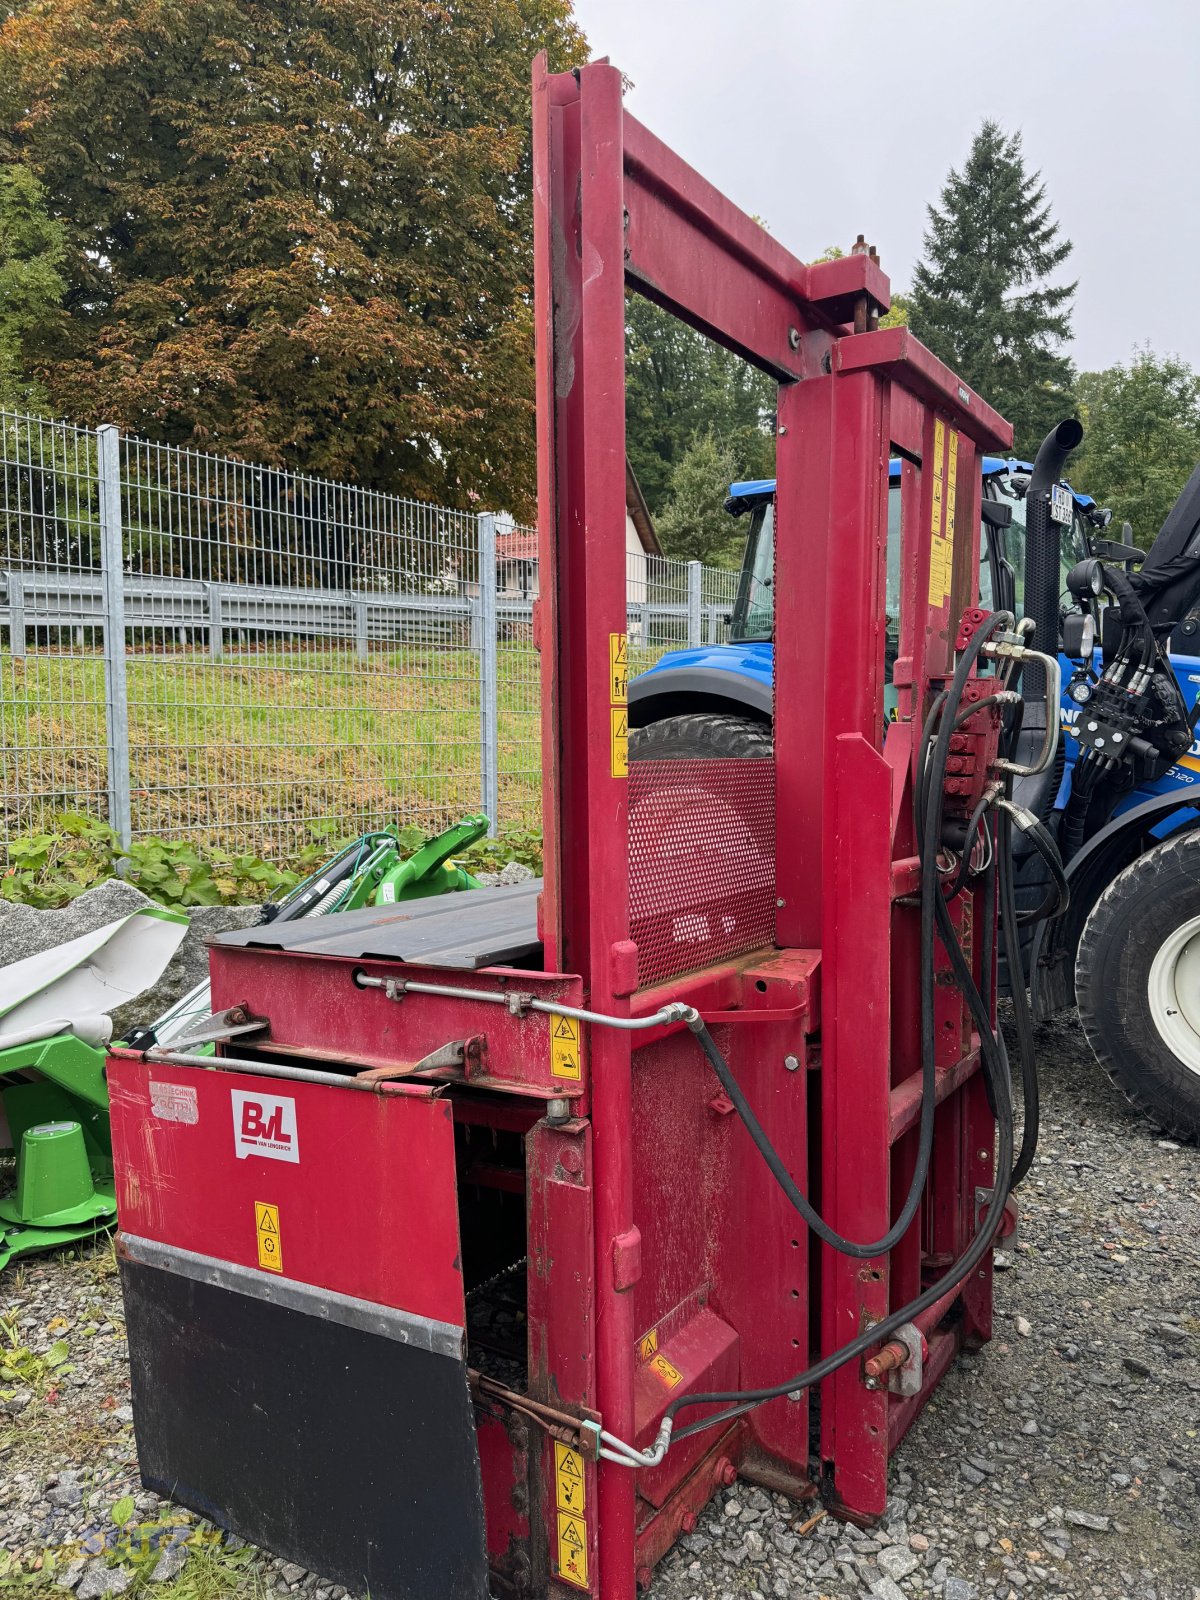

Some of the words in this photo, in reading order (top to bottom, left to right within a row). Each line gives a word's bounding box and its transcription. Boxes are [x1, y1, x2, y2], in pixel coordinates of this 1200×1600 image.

[257, 1140, 267, 1148] VAN
[267, 1142, 291, 1152] LENGERICH
[263, 1253, 278, 1262] STOP
